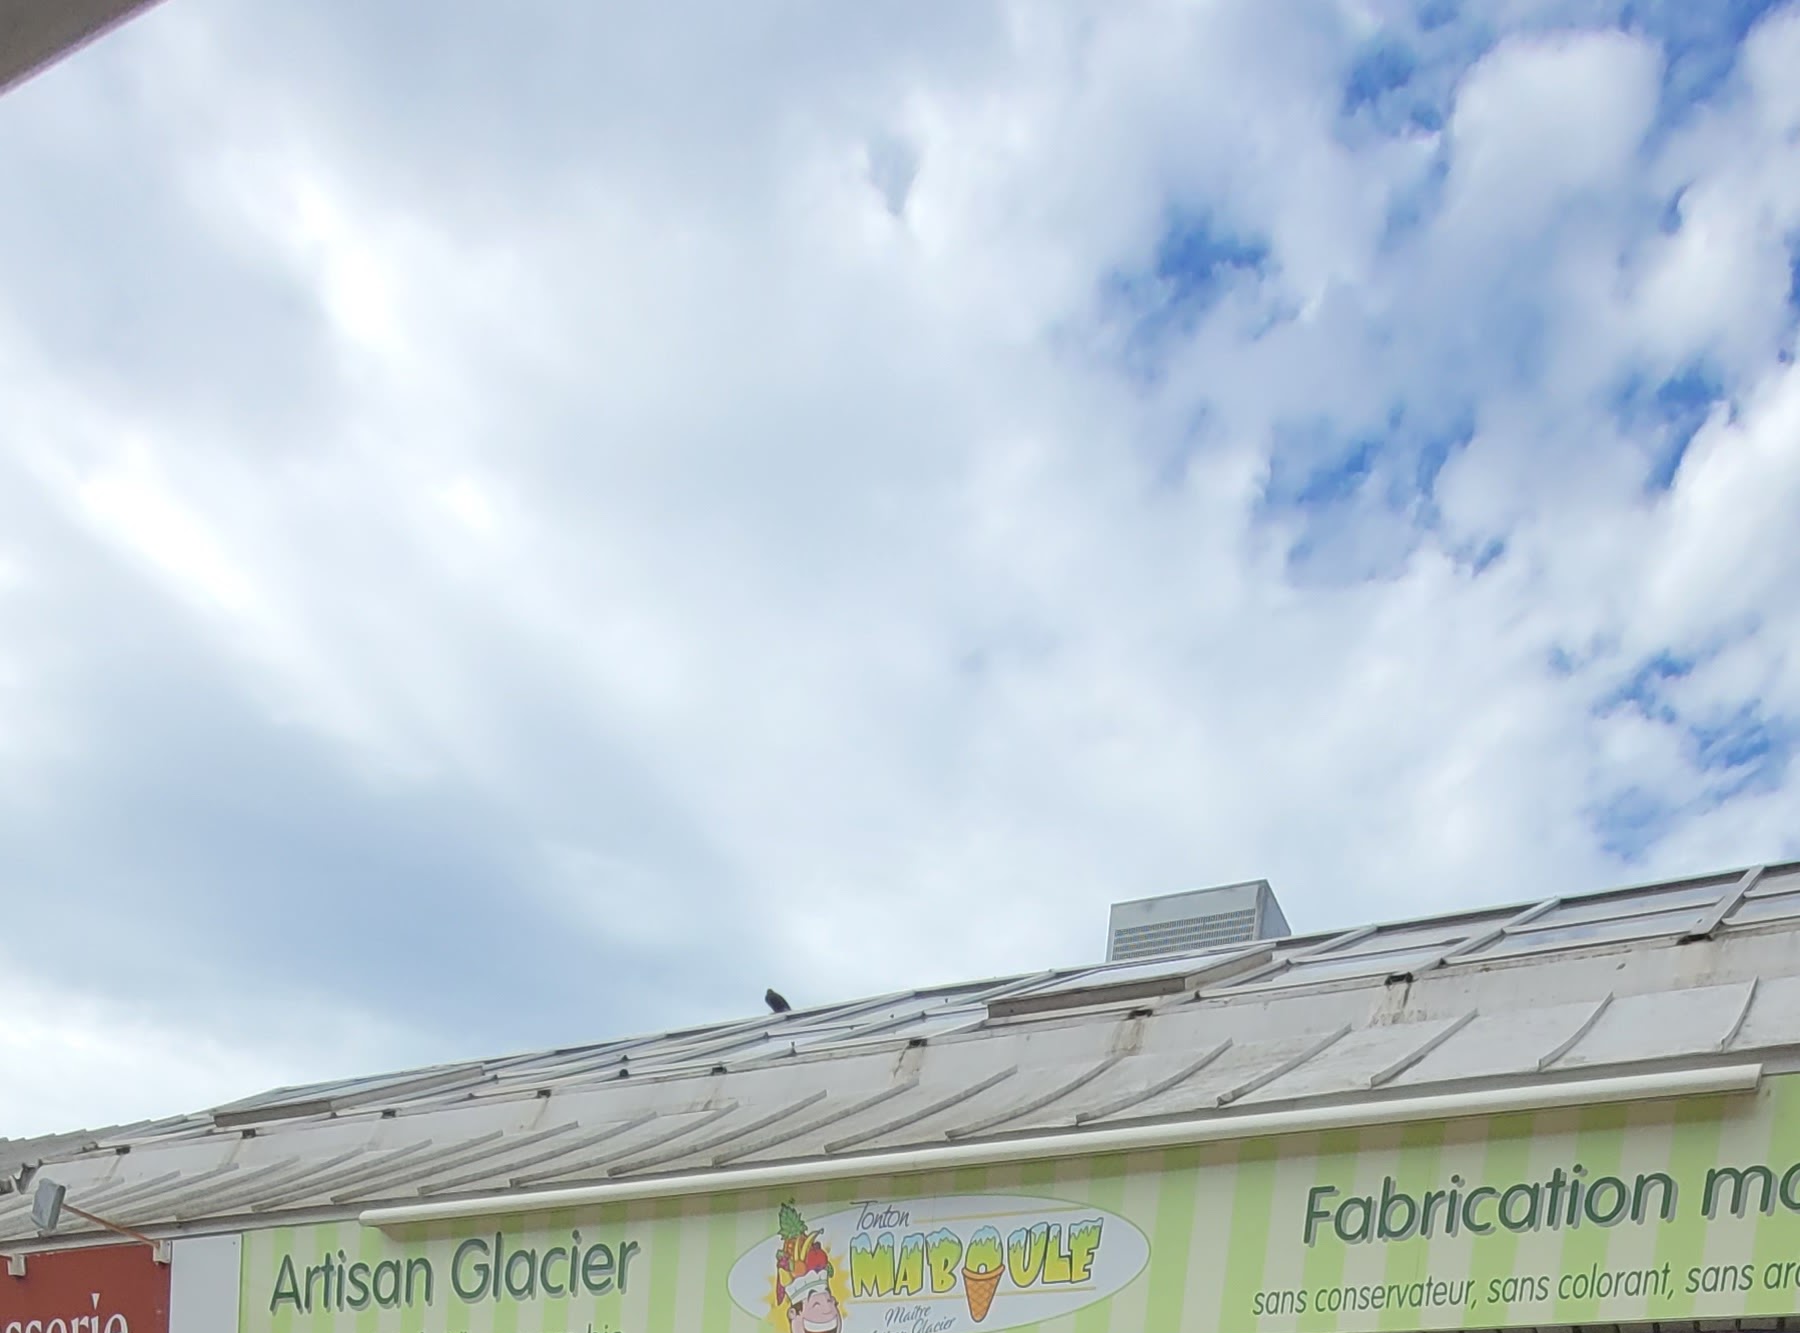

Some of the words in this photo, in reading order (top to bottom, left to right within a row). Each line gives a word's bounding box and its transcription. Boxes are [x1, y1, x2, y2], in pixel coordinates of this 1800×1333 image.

[850, 1200, 910, 1231] Tonton
[1303, 1163, 1679, 1248] Fabrication
[269, 1249, 435, 1316] Artisan
[451, 1229, 641, 1304] Glacier
[850, 1217, 1104, 1298] MABOULE
[1252, 1289, 1307, 1316] sans
[1315, 1275, 1478, 1311] conservateur,
[1487, 1275, 1550, 1304] sans
[1558, 1262, 1674, 1301] colorant,
[1685, 1264, 1755, 1294] sans
[1763, 1261, 1800, 1290] ar
